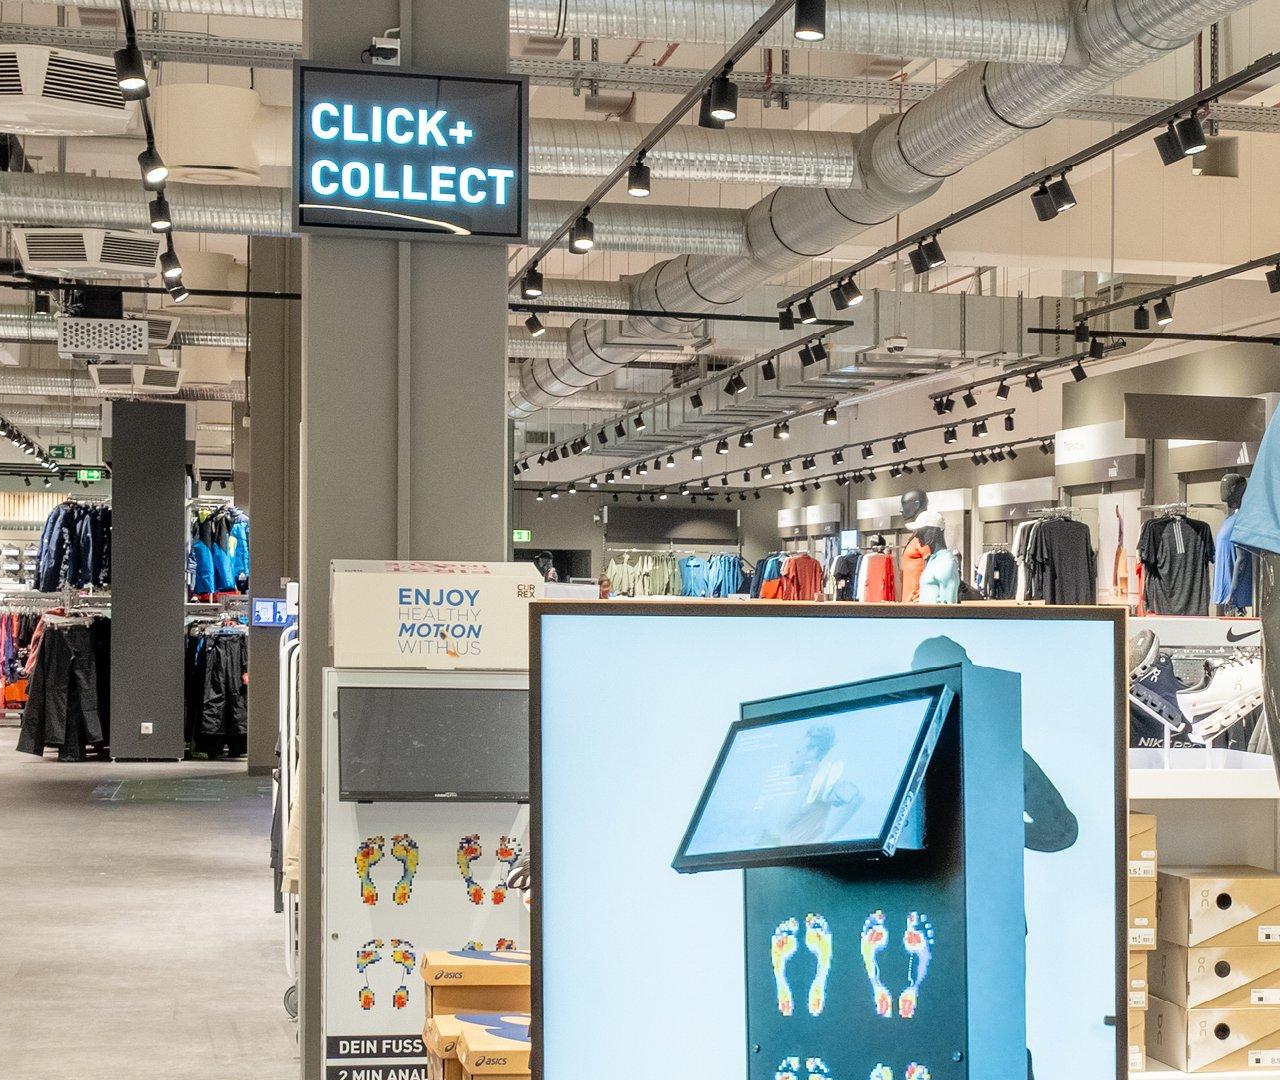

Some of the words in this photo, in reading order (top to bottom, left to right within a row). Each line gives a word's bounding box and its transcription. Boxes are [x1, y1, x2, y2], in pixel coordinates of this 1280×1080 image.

[311, 102, 473, 147] CLICK+
[311, 159, 514, 205] COLLECT
[517, 584, 536, 592] CUR
[398, 588, 480, 606] ENJOY
[398, 607, 482, 622] HEALTHY
[398, 623, 482, 639] MOTION
[398, 640, 449, 655] WITH
[456, 640, 482, 656] US
[1138, 737, 1165, 748] NIK
[443, 970, 463, 979] asics
[339, 1040, 377, 1054] DEIN
[381, 1039, 423, 1053] FUSS
[485, 1057, 507, 1066] asics
